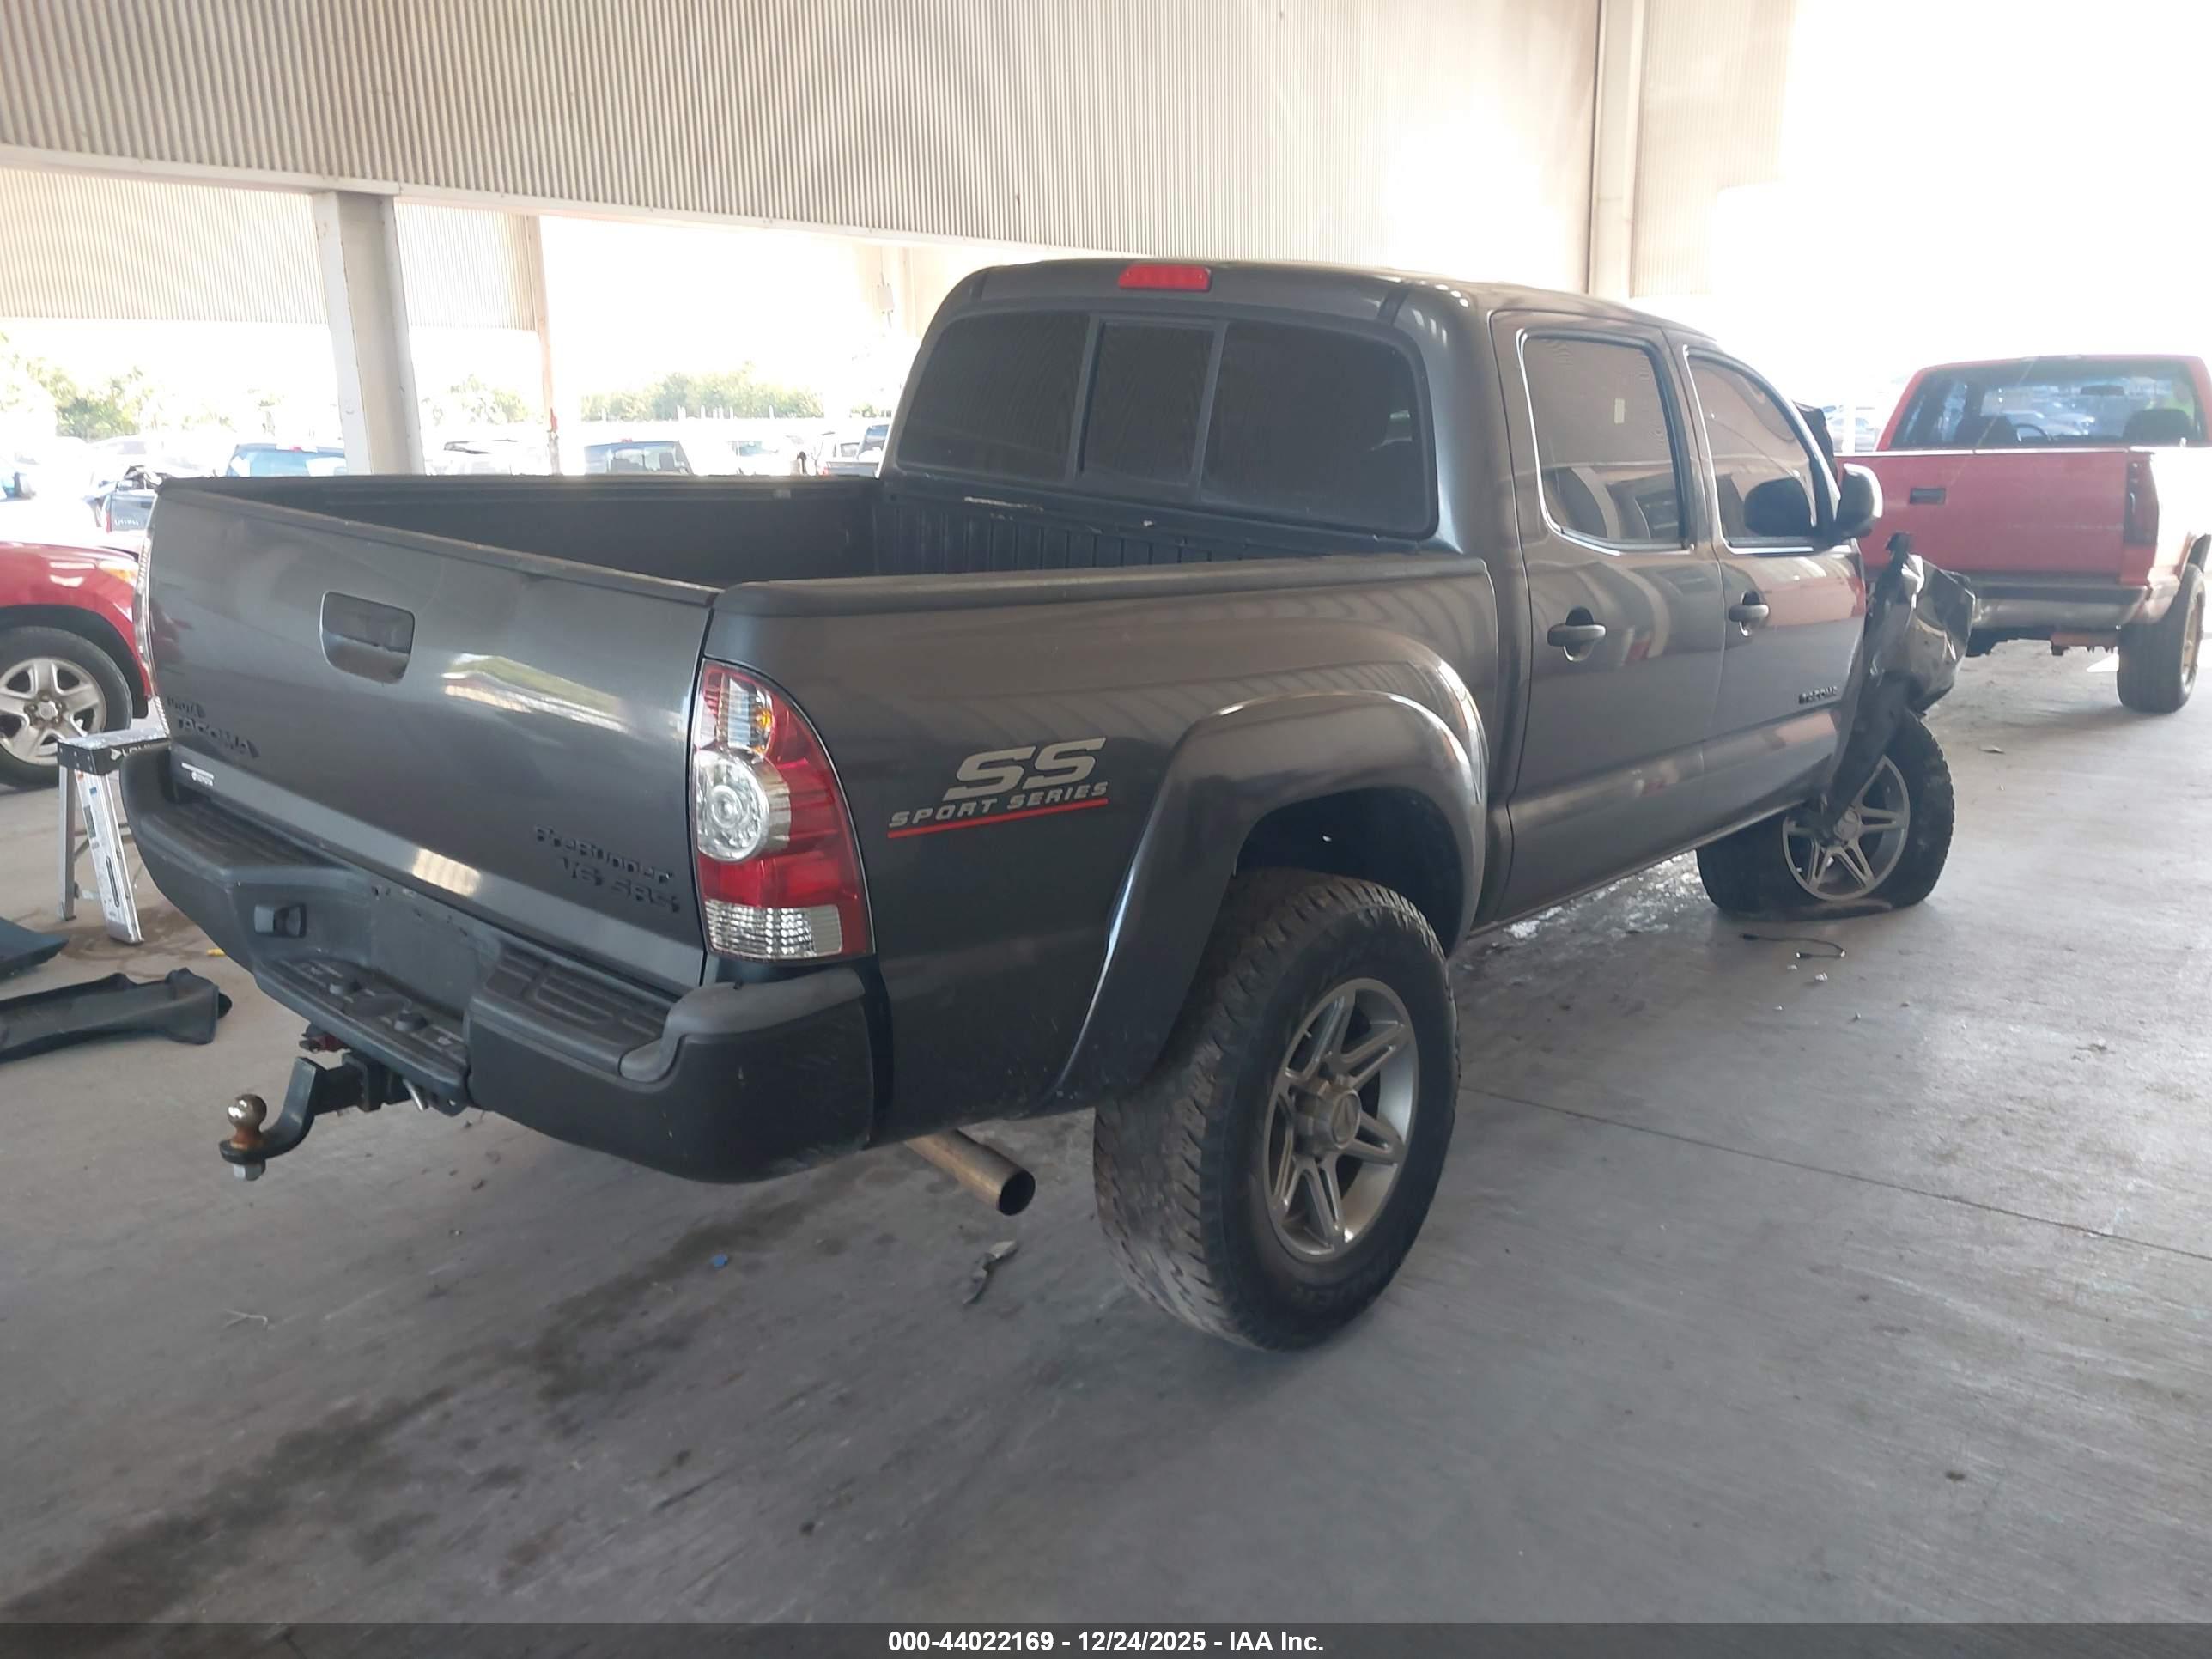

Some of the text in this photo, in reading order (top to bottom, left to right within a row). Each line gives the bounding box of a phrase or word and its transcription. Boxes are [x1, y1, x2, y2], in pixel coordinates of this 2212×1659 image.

[942, 737, 1107, 800] SS
[888, 781, 1109, 828] SPORT SERIES
[559, 855, 681, 914] V6 SR5
